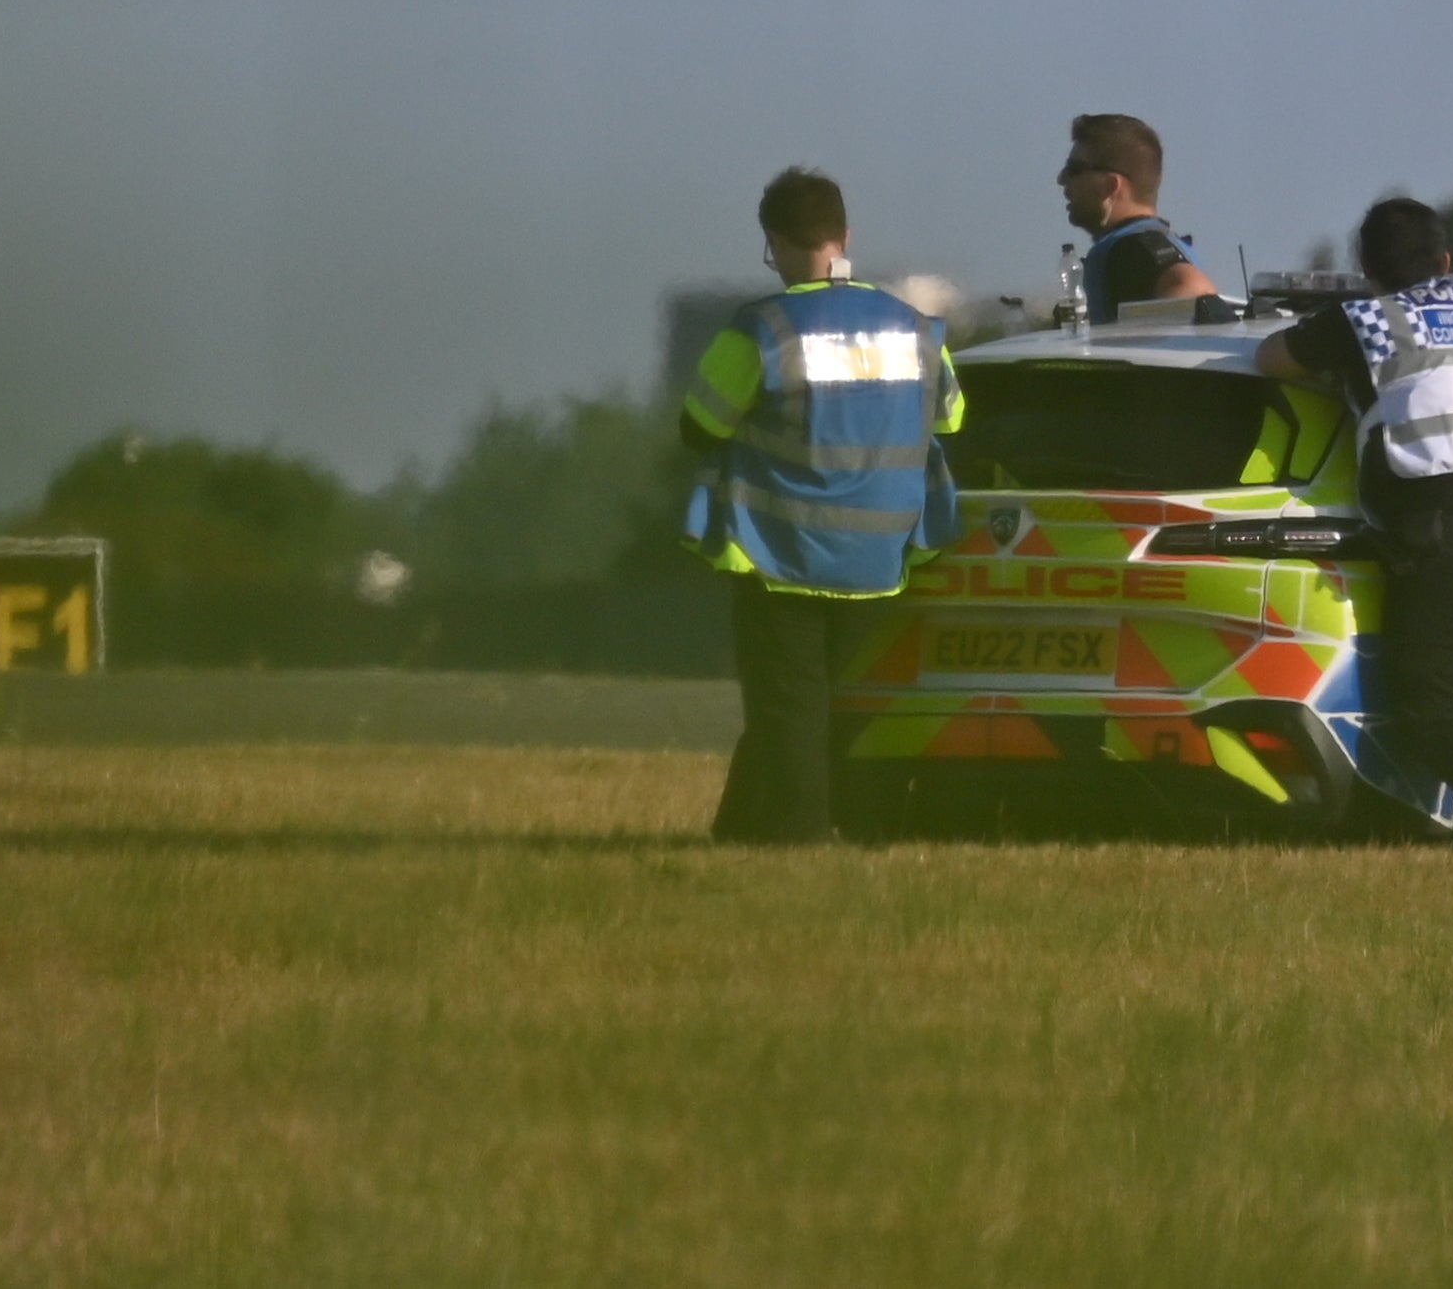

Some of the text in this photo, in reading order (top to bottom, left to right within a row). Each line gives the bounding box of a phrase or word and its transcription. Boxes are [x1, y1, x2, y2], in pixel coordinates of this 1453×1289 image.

[906, 564, 1187, 600] OLICE
[936, 629, 1104, 668] EU22 FSX
